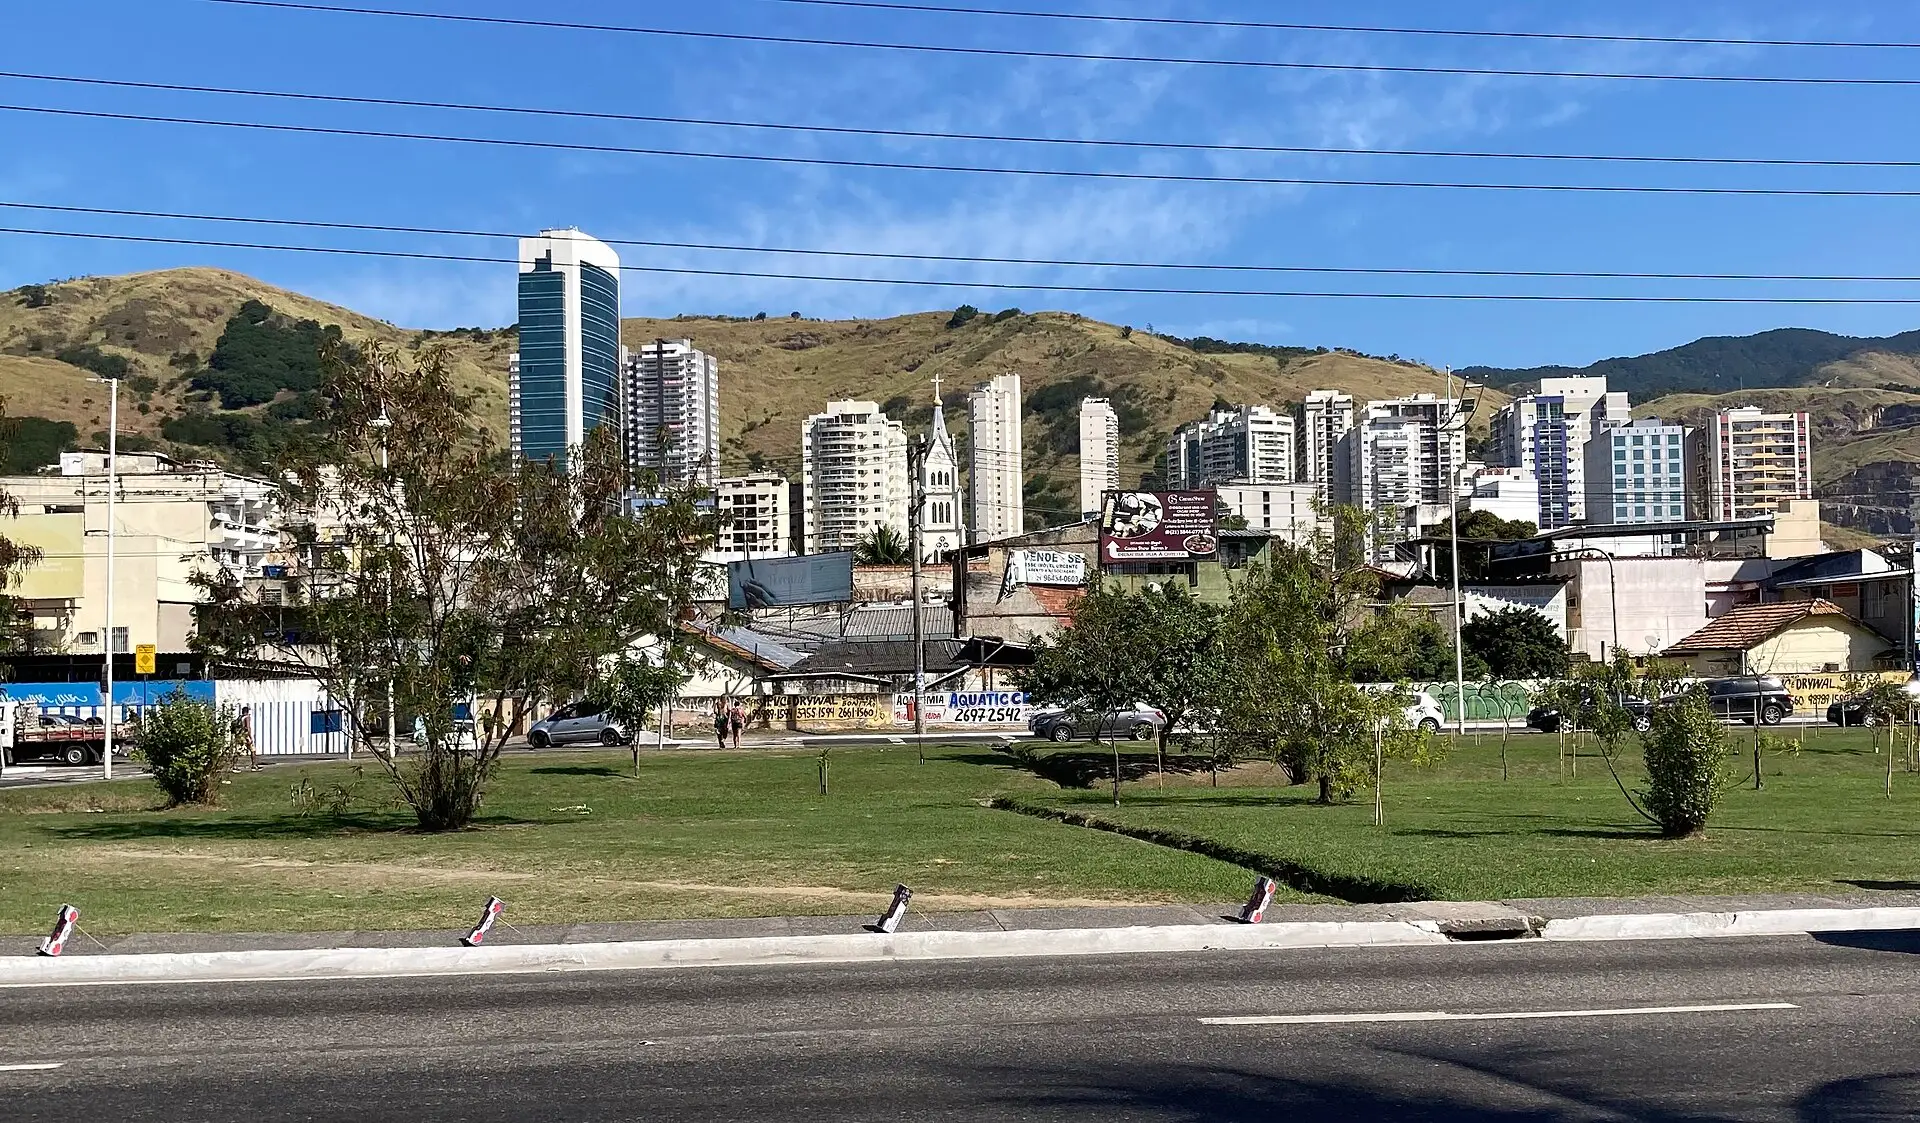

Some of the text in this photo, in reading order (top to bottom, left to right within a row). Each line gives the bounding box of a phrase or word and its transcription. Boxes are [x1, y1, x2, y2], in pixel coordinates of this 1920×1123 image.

[1023, 551, 1058, 562] VENDE
[1067, 554, 1081, 563] SE
[1796, 678, 1836, 690] DRYWAL
[793, 696, 838, 707] DRYWAL
[896, 694, 944, 706] ACAMIA
[949, 692, 1008, 709] AQUATIC
